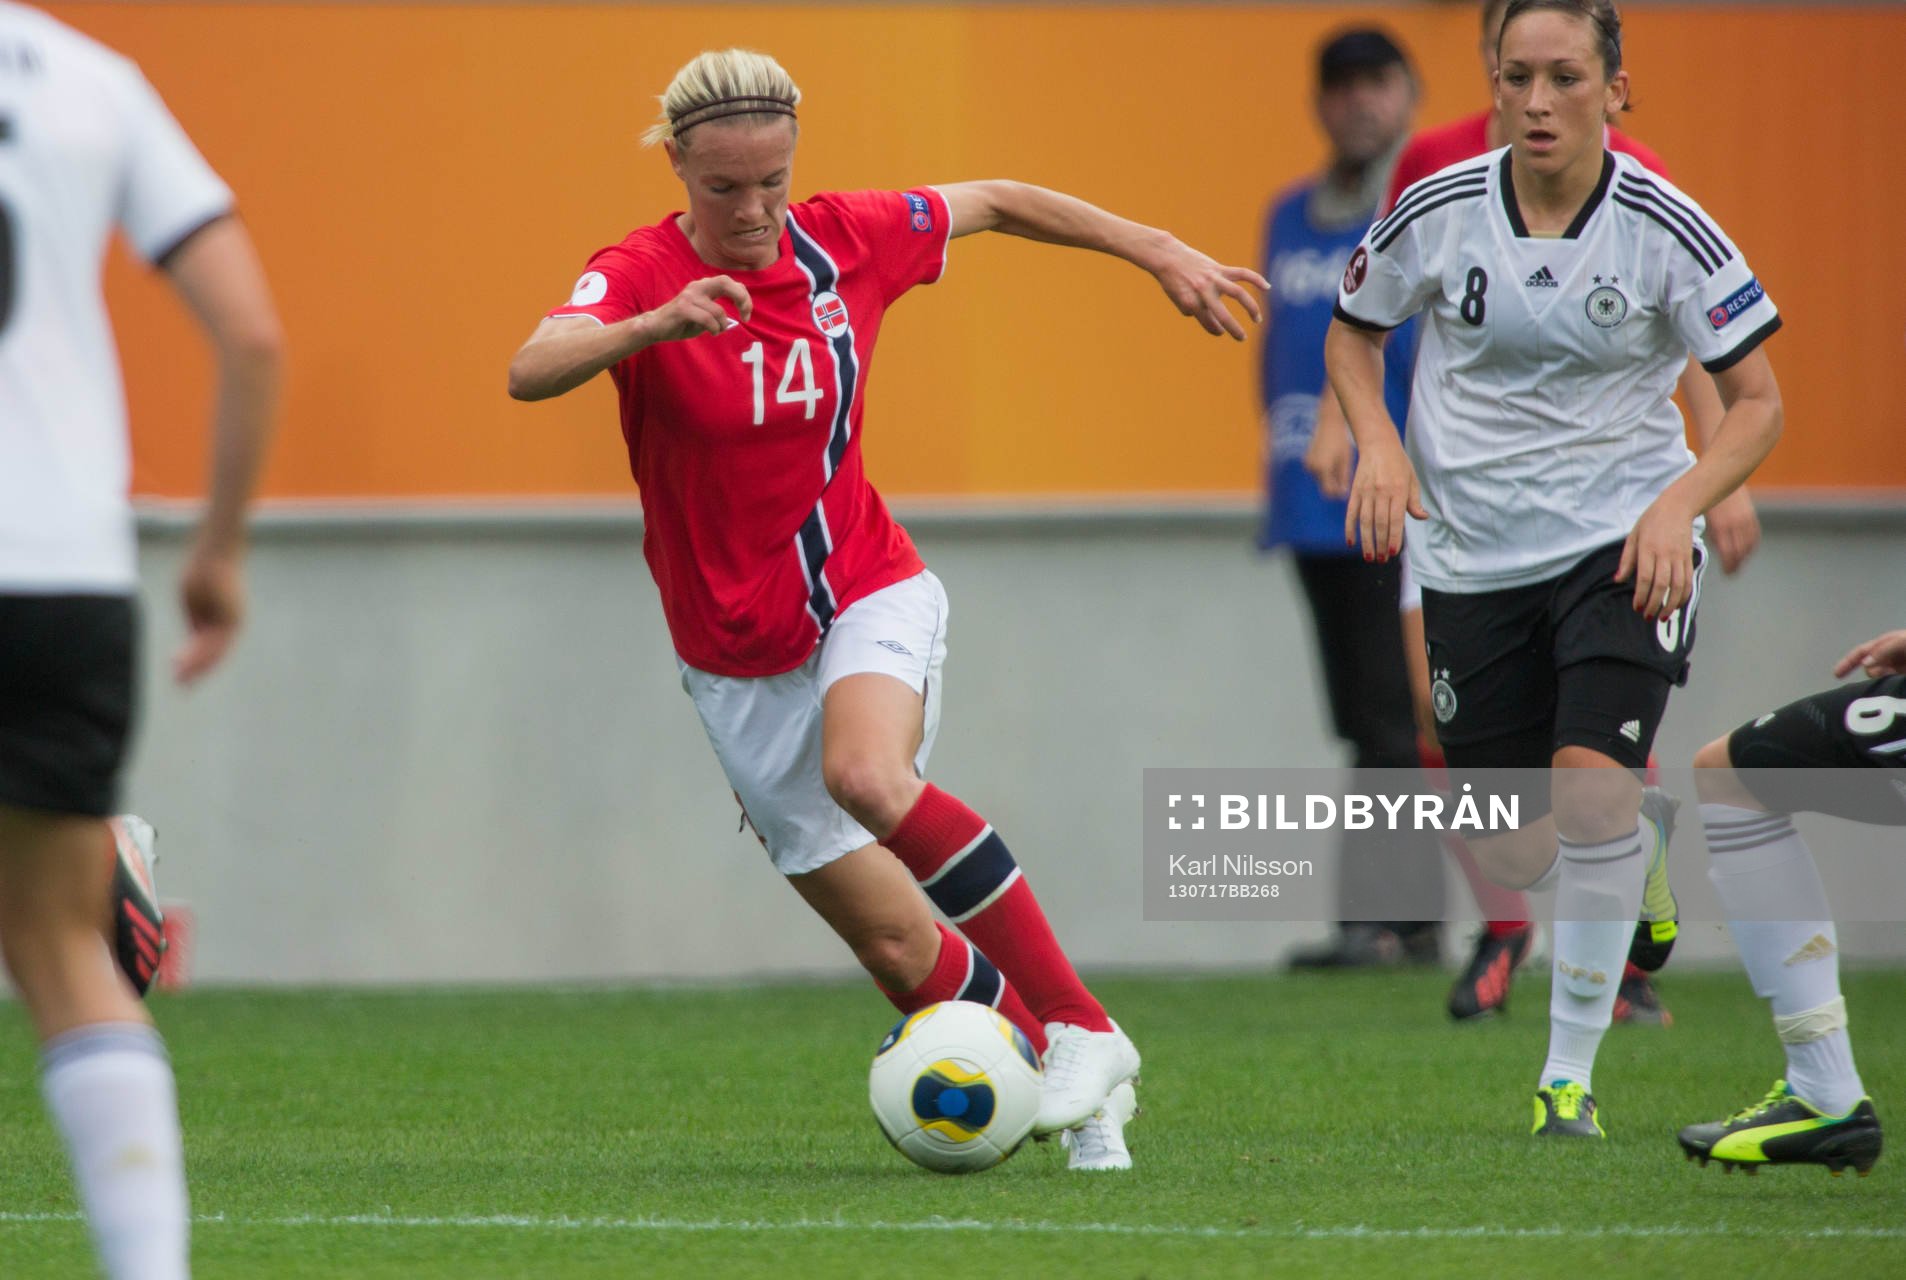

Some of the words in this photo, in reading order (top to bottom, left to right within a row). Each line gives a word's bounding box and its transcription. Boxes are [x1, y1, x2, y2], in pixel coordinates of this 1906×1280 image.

[1460, 266, 1488, 326] 8
[1525, 280, 1559, 288] adidas
[741, 338, 824, 425] 14
